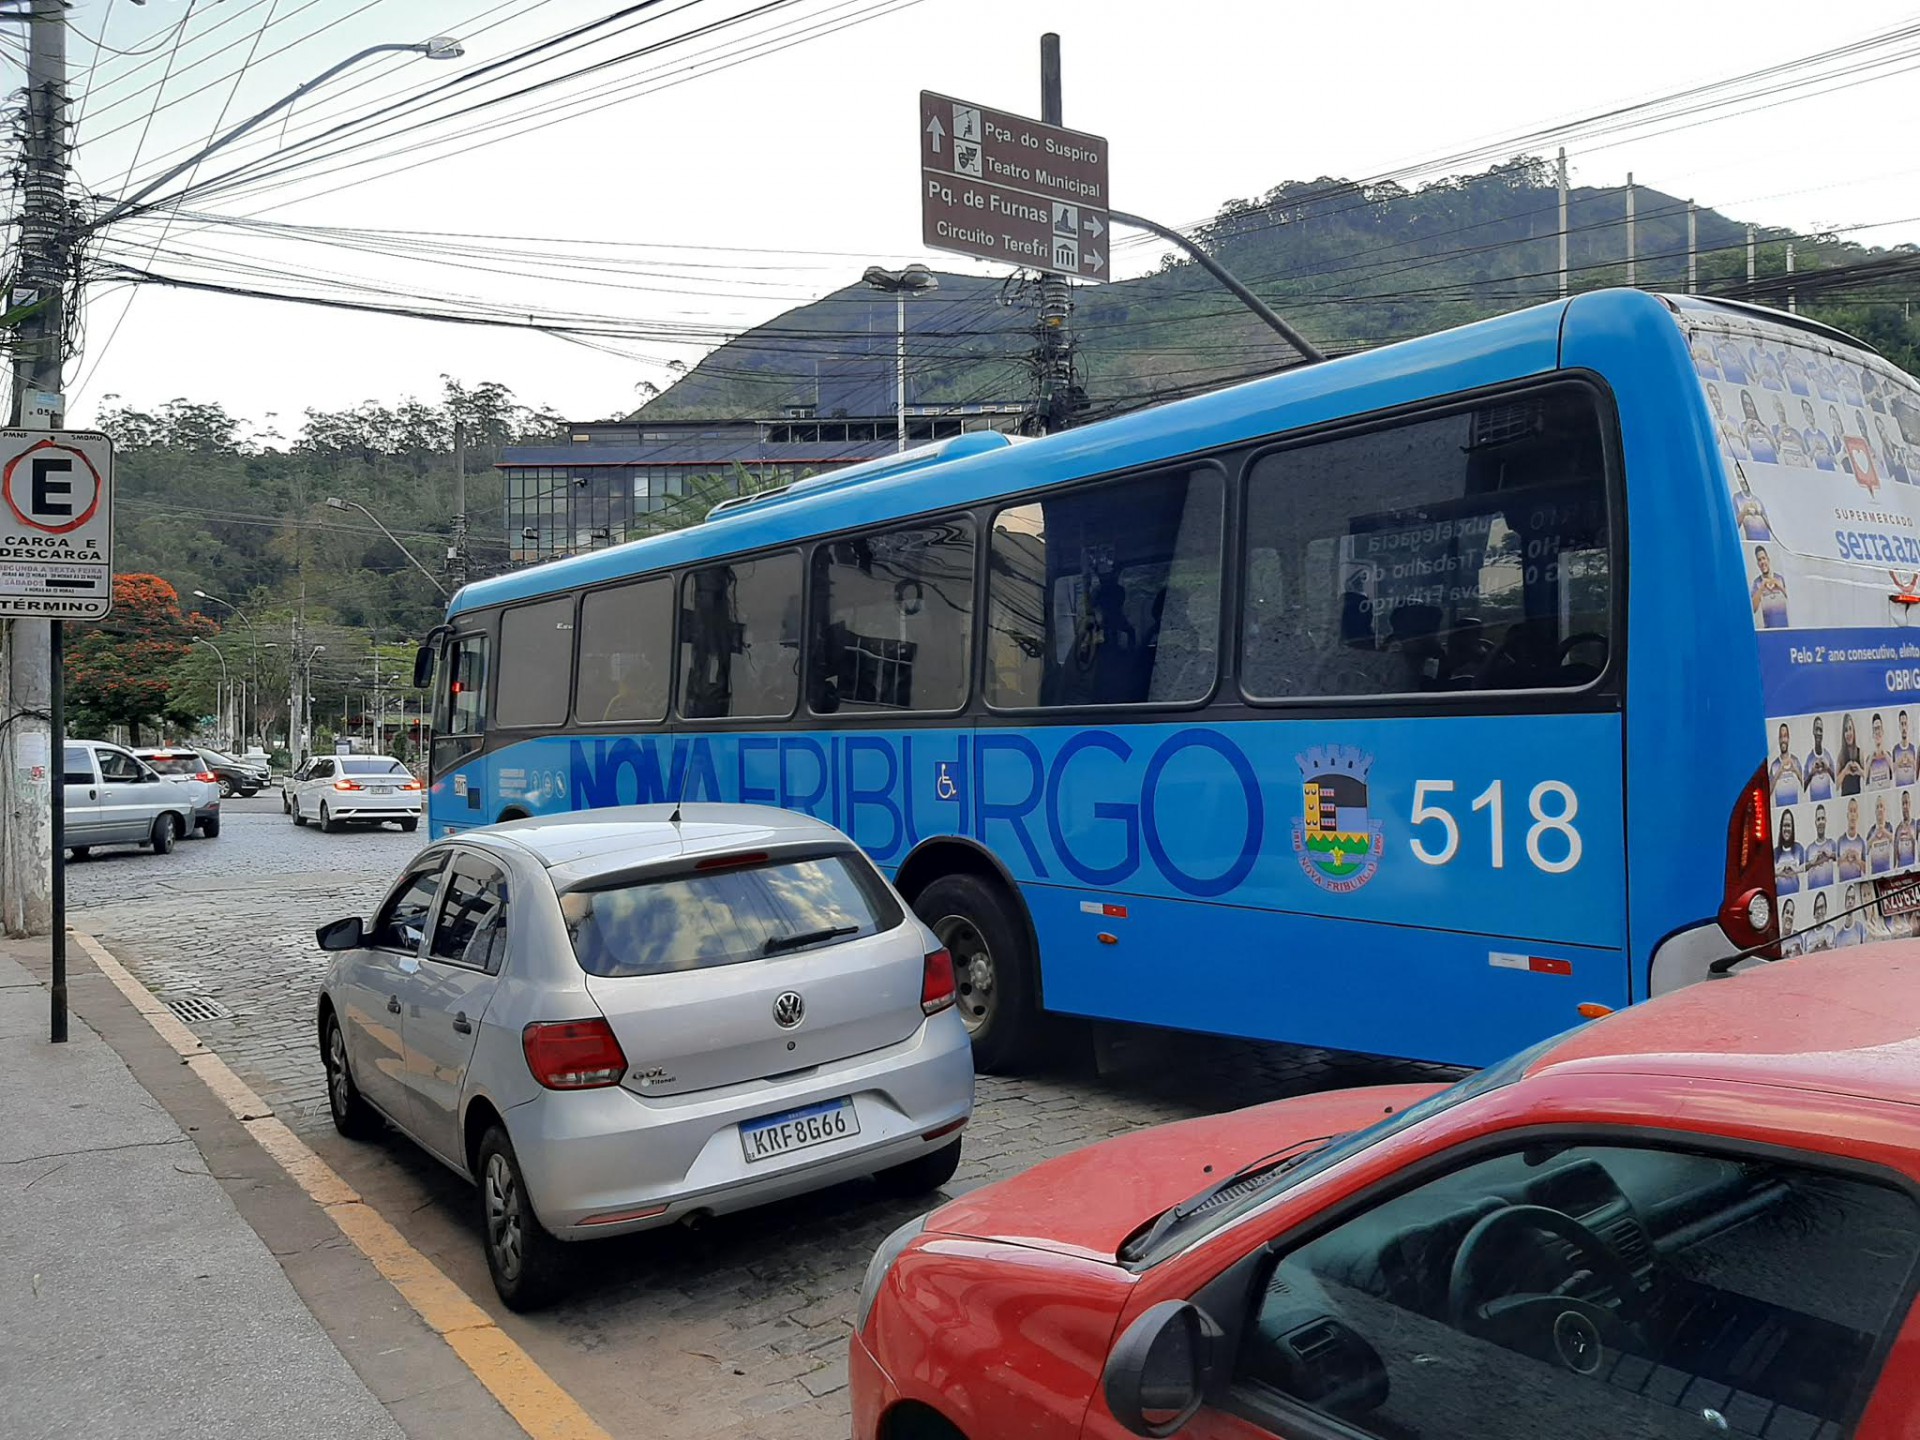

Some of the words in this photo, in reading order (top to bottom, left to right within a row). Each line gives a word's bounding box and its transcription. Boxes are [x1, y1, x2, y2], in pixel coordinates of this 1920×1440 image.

[985, 122, 1015, 144] Pça.
[1020, 132, 1039, 149] do
[1045, 138, 1098, 164] Suspiro
[986, 156, 1030, 180] Teatro
[1035, 169, 1100, 197] Municipal
[928, 180, 958, 206] Pq.
[963, 190, 985, 209] de
[990, 194, 1048, 224] Furnas
[936, 220, 995, 247] Circuito
[1002, 234, 1048, 257] Terefri
[32, 458, 73, 515] E
[1835, 508, 1913, 527] SUPERMERCADO
[0, 548, 102, 560] DESCARGA
[5, 536, 70, 548] CARGA
[86, 539, 97, 549] E
[0, 598, 99, 612] TÉRMINO
[1790, 646, 1812, 664] Pelo
[1828, 650, 1845, 661] ano
[1847, 644, 1898, 660] consecutivo,
[570, 738, 722, 812] NOVA
[738, 728, 1264, 897] FRIBURGO
[1410, 780, 1582, 873] 518
[1302, 856, 1322, 885] NOVA
[1327, 863, 1376, 891] FRIBURGO
[753, 1111, 846, 1155] KRF8G66
